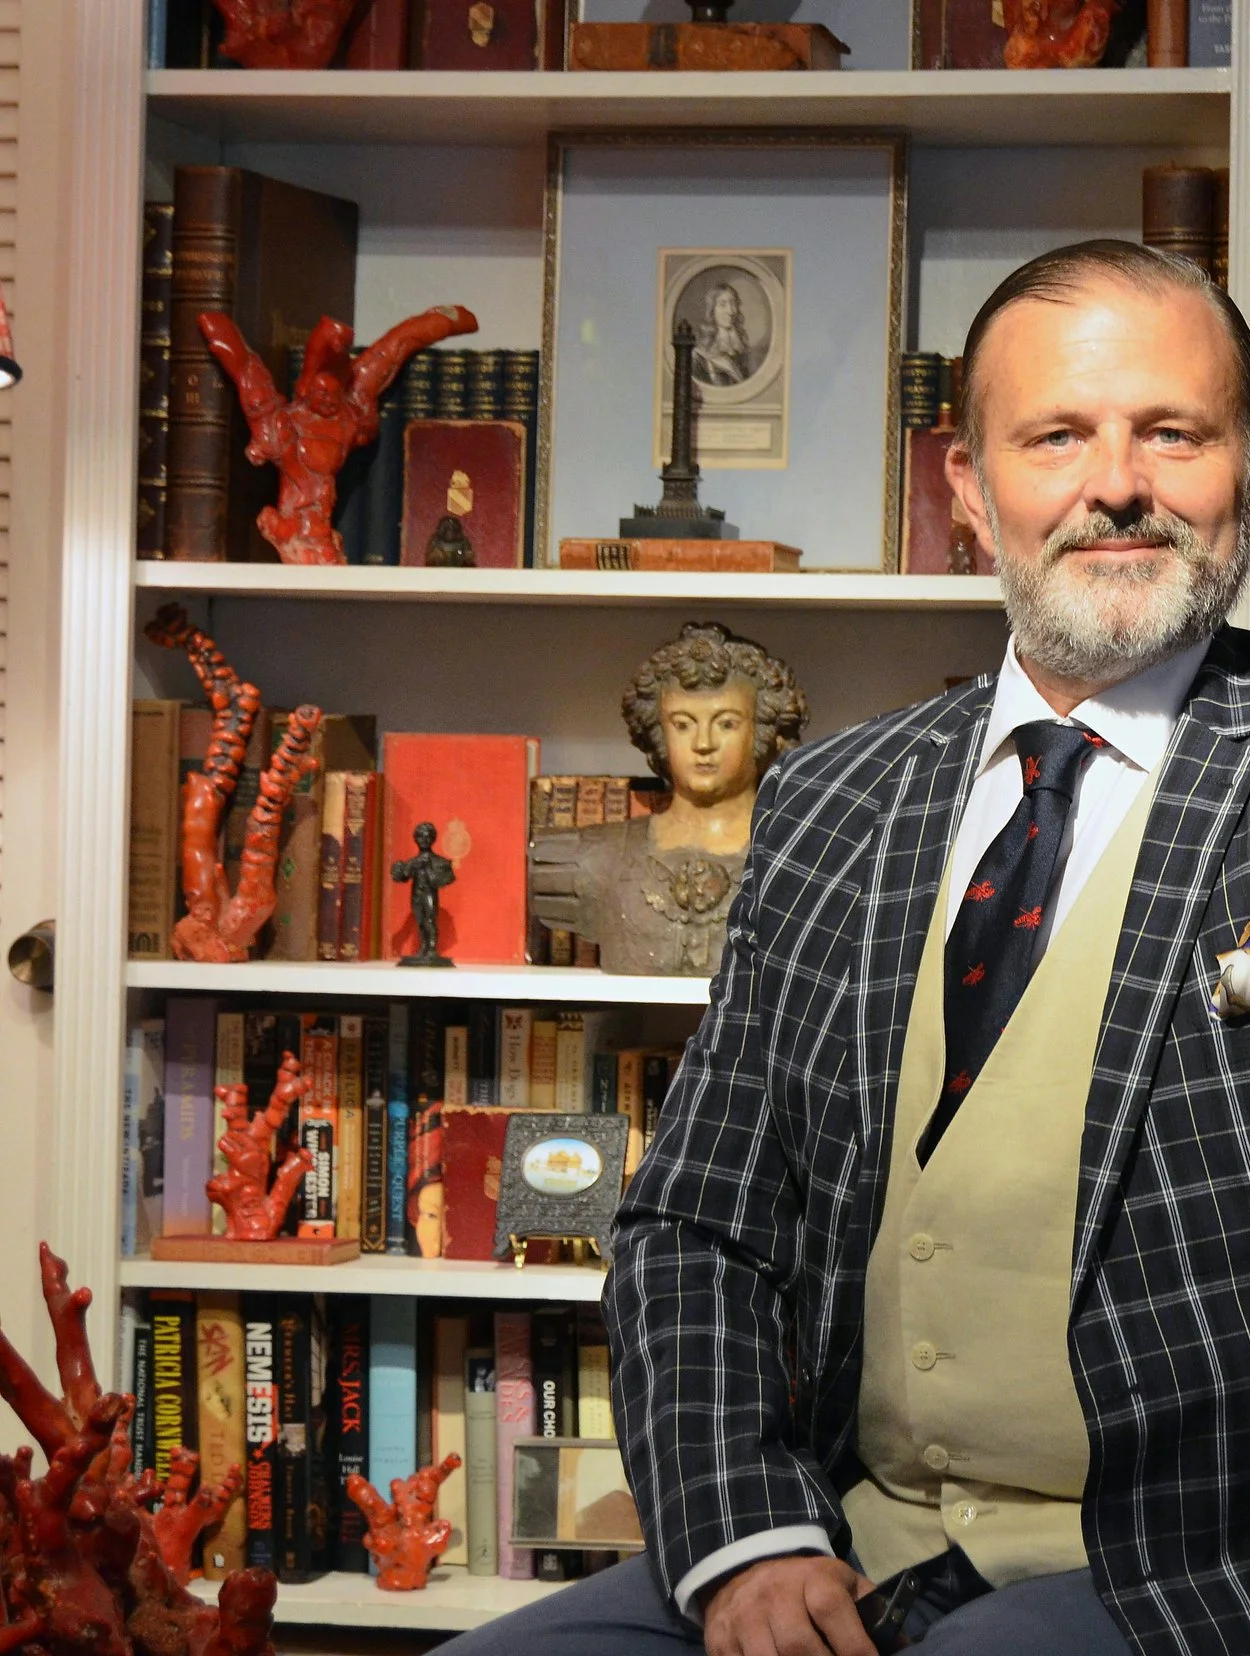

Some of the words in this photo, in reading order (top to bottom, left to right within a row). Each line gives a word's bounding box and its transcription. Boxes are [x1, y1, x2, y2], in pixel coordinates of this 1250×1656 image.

[391, 1116, 405, 1171] PURPLE
[318, 1152, 330, 1198] SIMON
[391, 1174, 405, 1223] QUEST
[136, 1338, 147, 1357] THE
[153, 1315, 182, 1390] PATRICIA
[342, 1323, 361, 1376] MRS.
[135, 1359, 147, 1408] NATIONAL
[245, 1322, 274, 1443] NEMESIS
[336, 1379, 362, 1435] JACK
[542, 1380, 556, 1410] OUR
[135, 1412, 145, 1439] TRUST
[247, 1460, 261, 1530] JOHNSON
[259, 1460, 273, 1530] CHALMERS
